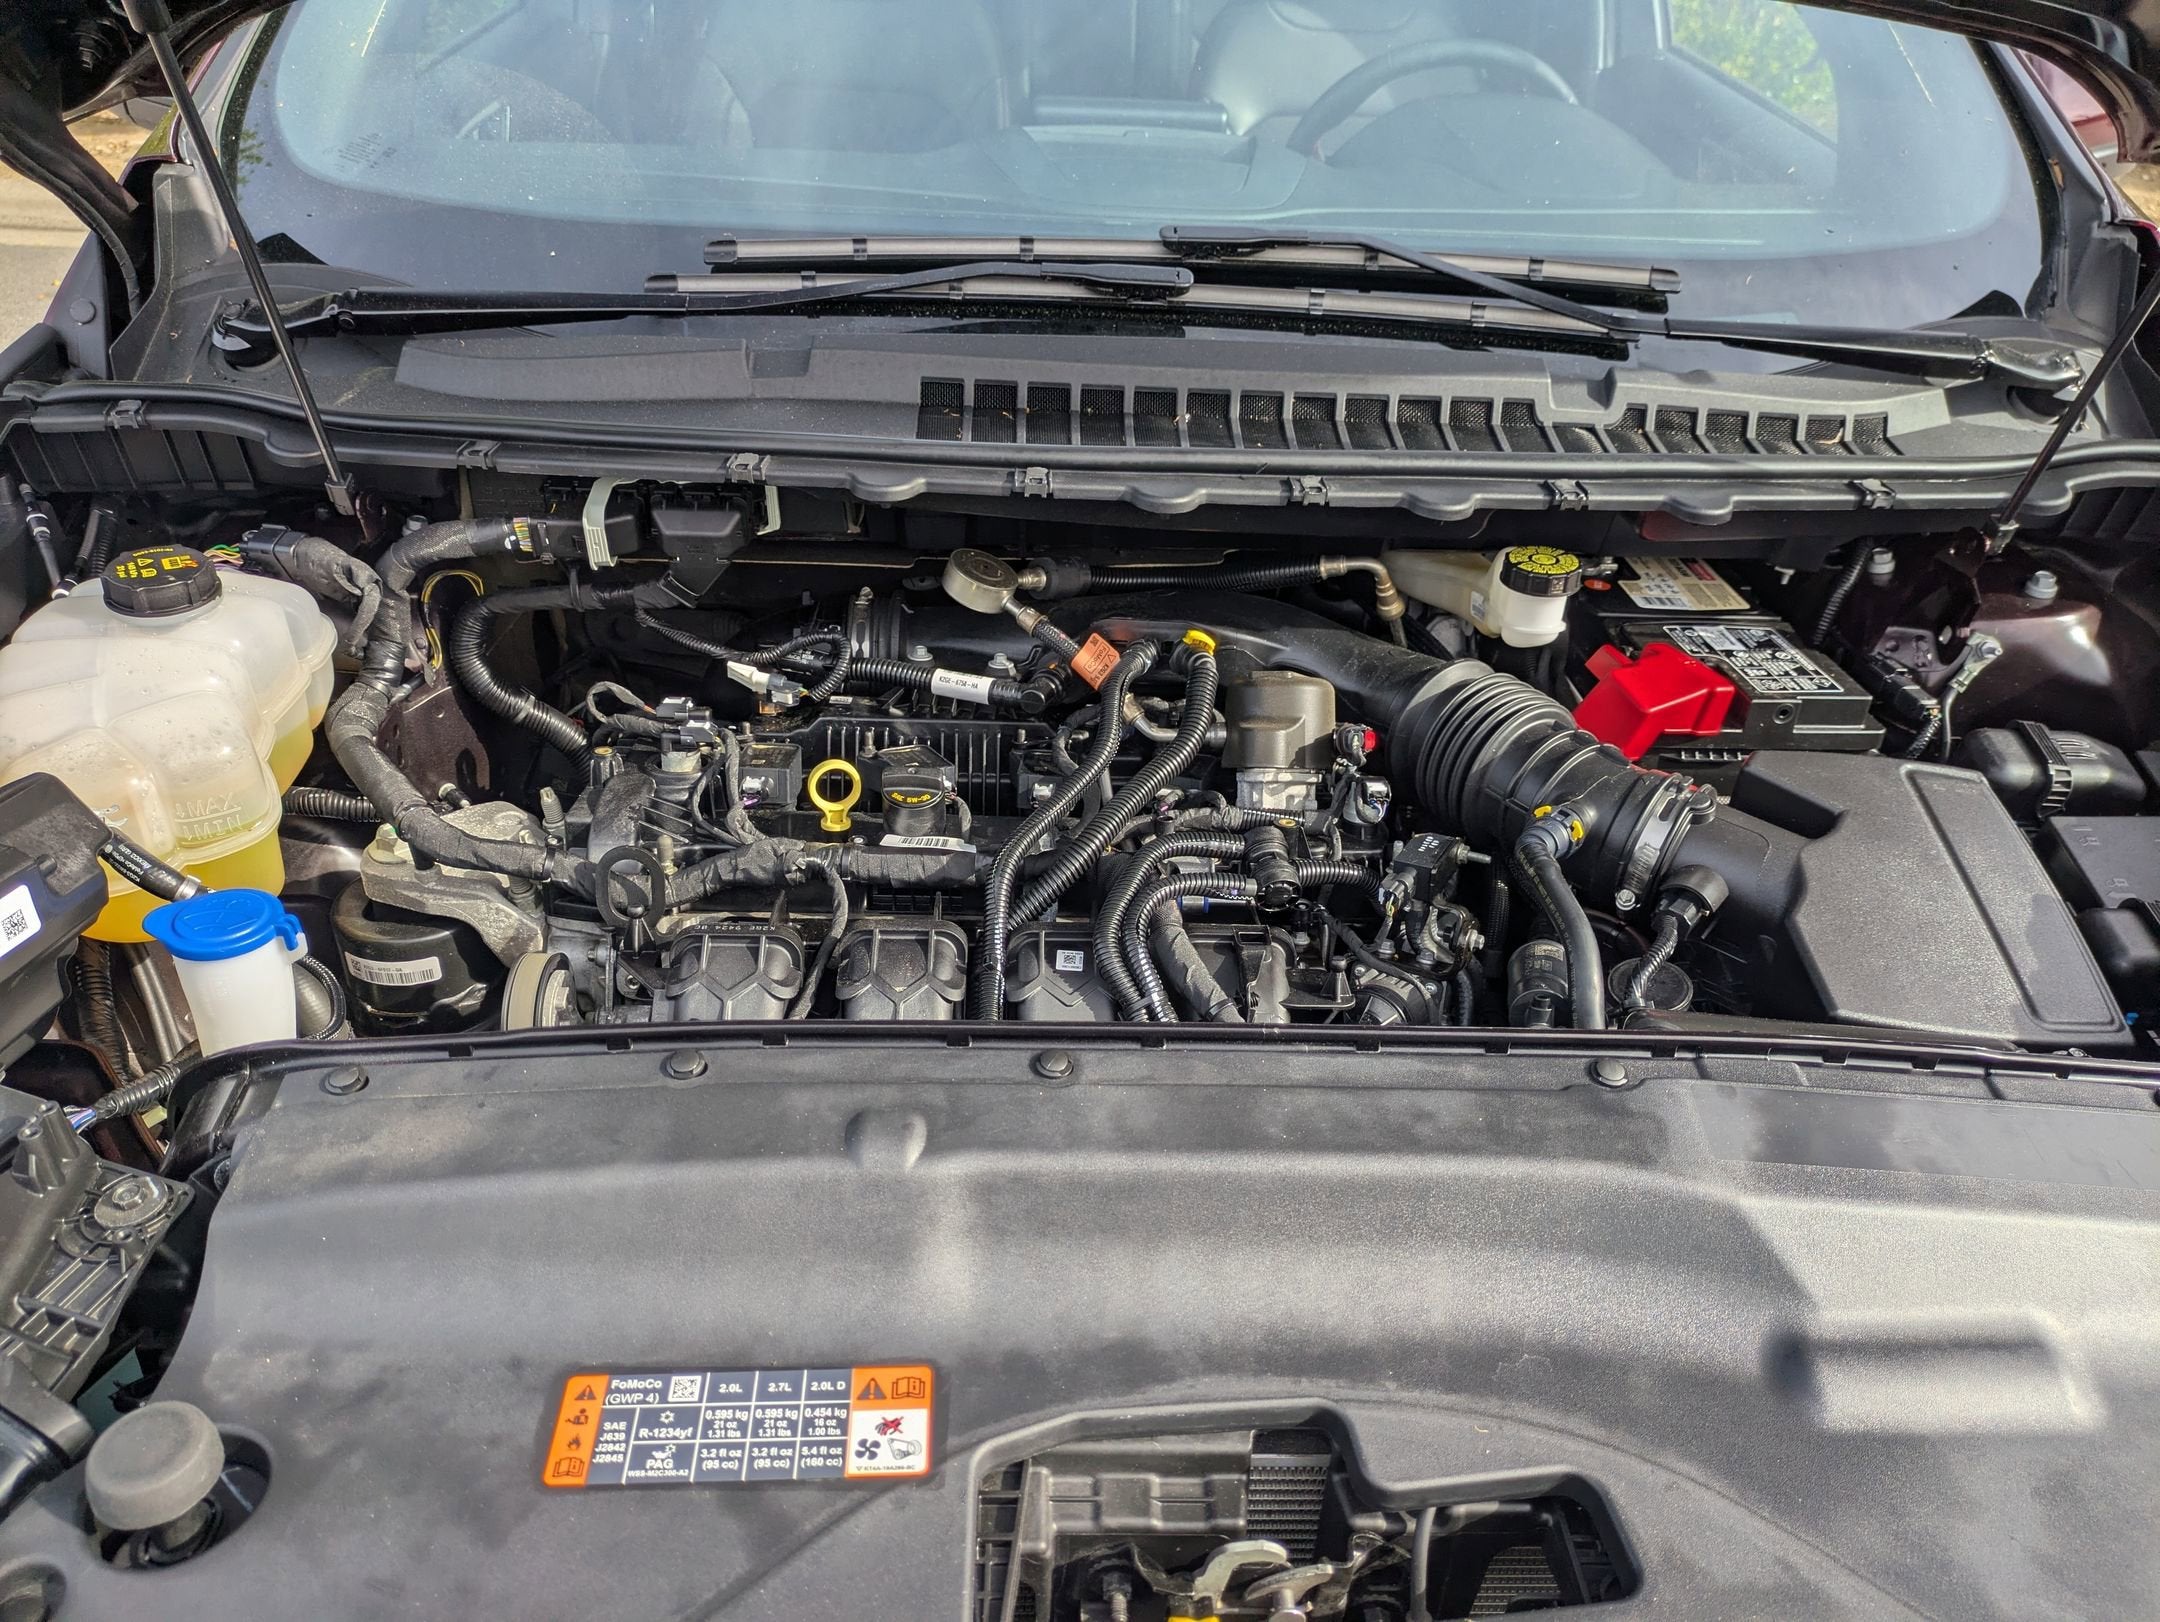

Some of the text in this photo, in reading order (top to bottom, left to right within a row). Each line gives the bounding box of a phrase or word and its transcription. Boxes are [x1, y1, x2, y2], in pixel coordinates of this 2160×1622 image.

[891, 792, 931, 803] SAE 5W-30
[186, 792, 238, 817] MAX
[193, 815, 243, 840] MIN
[611, 1379, 662, 1390] FoMoCo
[718, 1384, 743, 1393] 2.0L
[767, 1382, 792, 1392] 2.7L
[810, 1381, 846, 1391] 2.0L D
[605, 1392, 660, 1406] (GWP 4)
[705, 1409, 749, 1421] 0.595 kg
[755, 1408, 798, 1420] 0.595 kg
[804, 1407, 847, 1419] 0.454 kg
[603, 1421, 627, 1431] SAE
[713, 1420, 725, 1428] 21
[763, 1419, 788, 1428] 21 oz
[600, 1432, 626, 1441] J639
[638, 1427, 693, 1439] R-1234yf
[707, 1429, 741, 1438] 1.31 lbs
[758, 1428, 792, 1437] 1.31 lbs
[807, 1427, 841, 1436] 1.00 lbs
[594, 1443, 626, 1452] J2842
[751, 1447, 769, 1457] 3.2
[782, 1448, 793, 1456] oz
[831, 1447, 843, 1455] oz
[700, 1448, 718, 1458] 3.2
[731, 1449, 742, 1457] oz
[592, 1454, 624, 1464] J2845
[753, 1458, 790, 1470] (95 cc)
[801, 1457, 843, 1469] (160 cc)
[646, 1459, 674, 1470] PAG
[702, 1459, 739, 1471] (95 cc)
